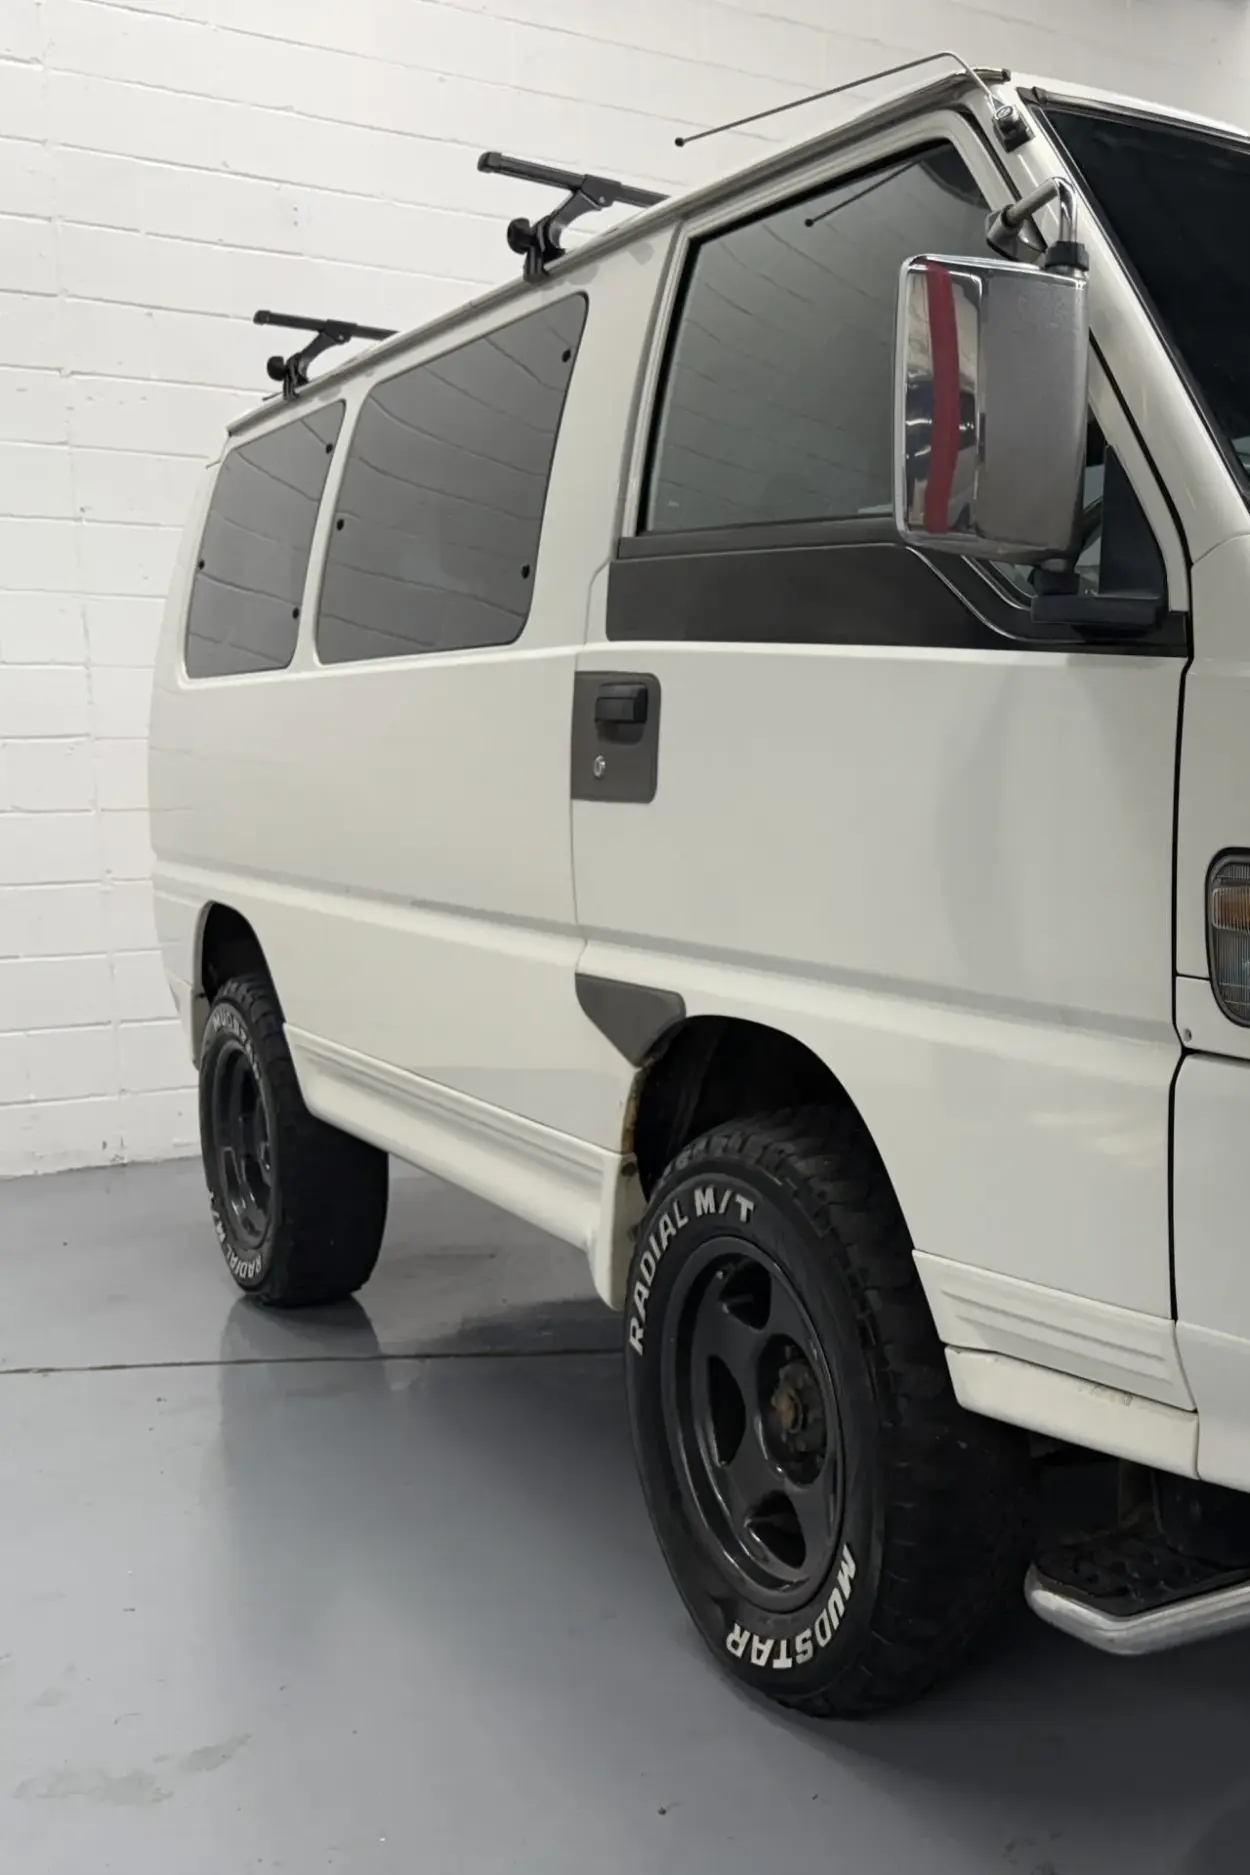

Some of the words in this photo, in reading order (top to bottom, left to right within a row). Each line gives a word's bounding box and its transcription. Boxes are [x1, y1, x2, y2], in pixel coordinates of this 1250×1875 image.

[226, 1243, 263, 1279] RADIAL
[628, 1202, 689, 1357] RADIAL
[694, 1184, 755, 1223] M/T
[725, 1543, 857, 1670] MUDSTAR
